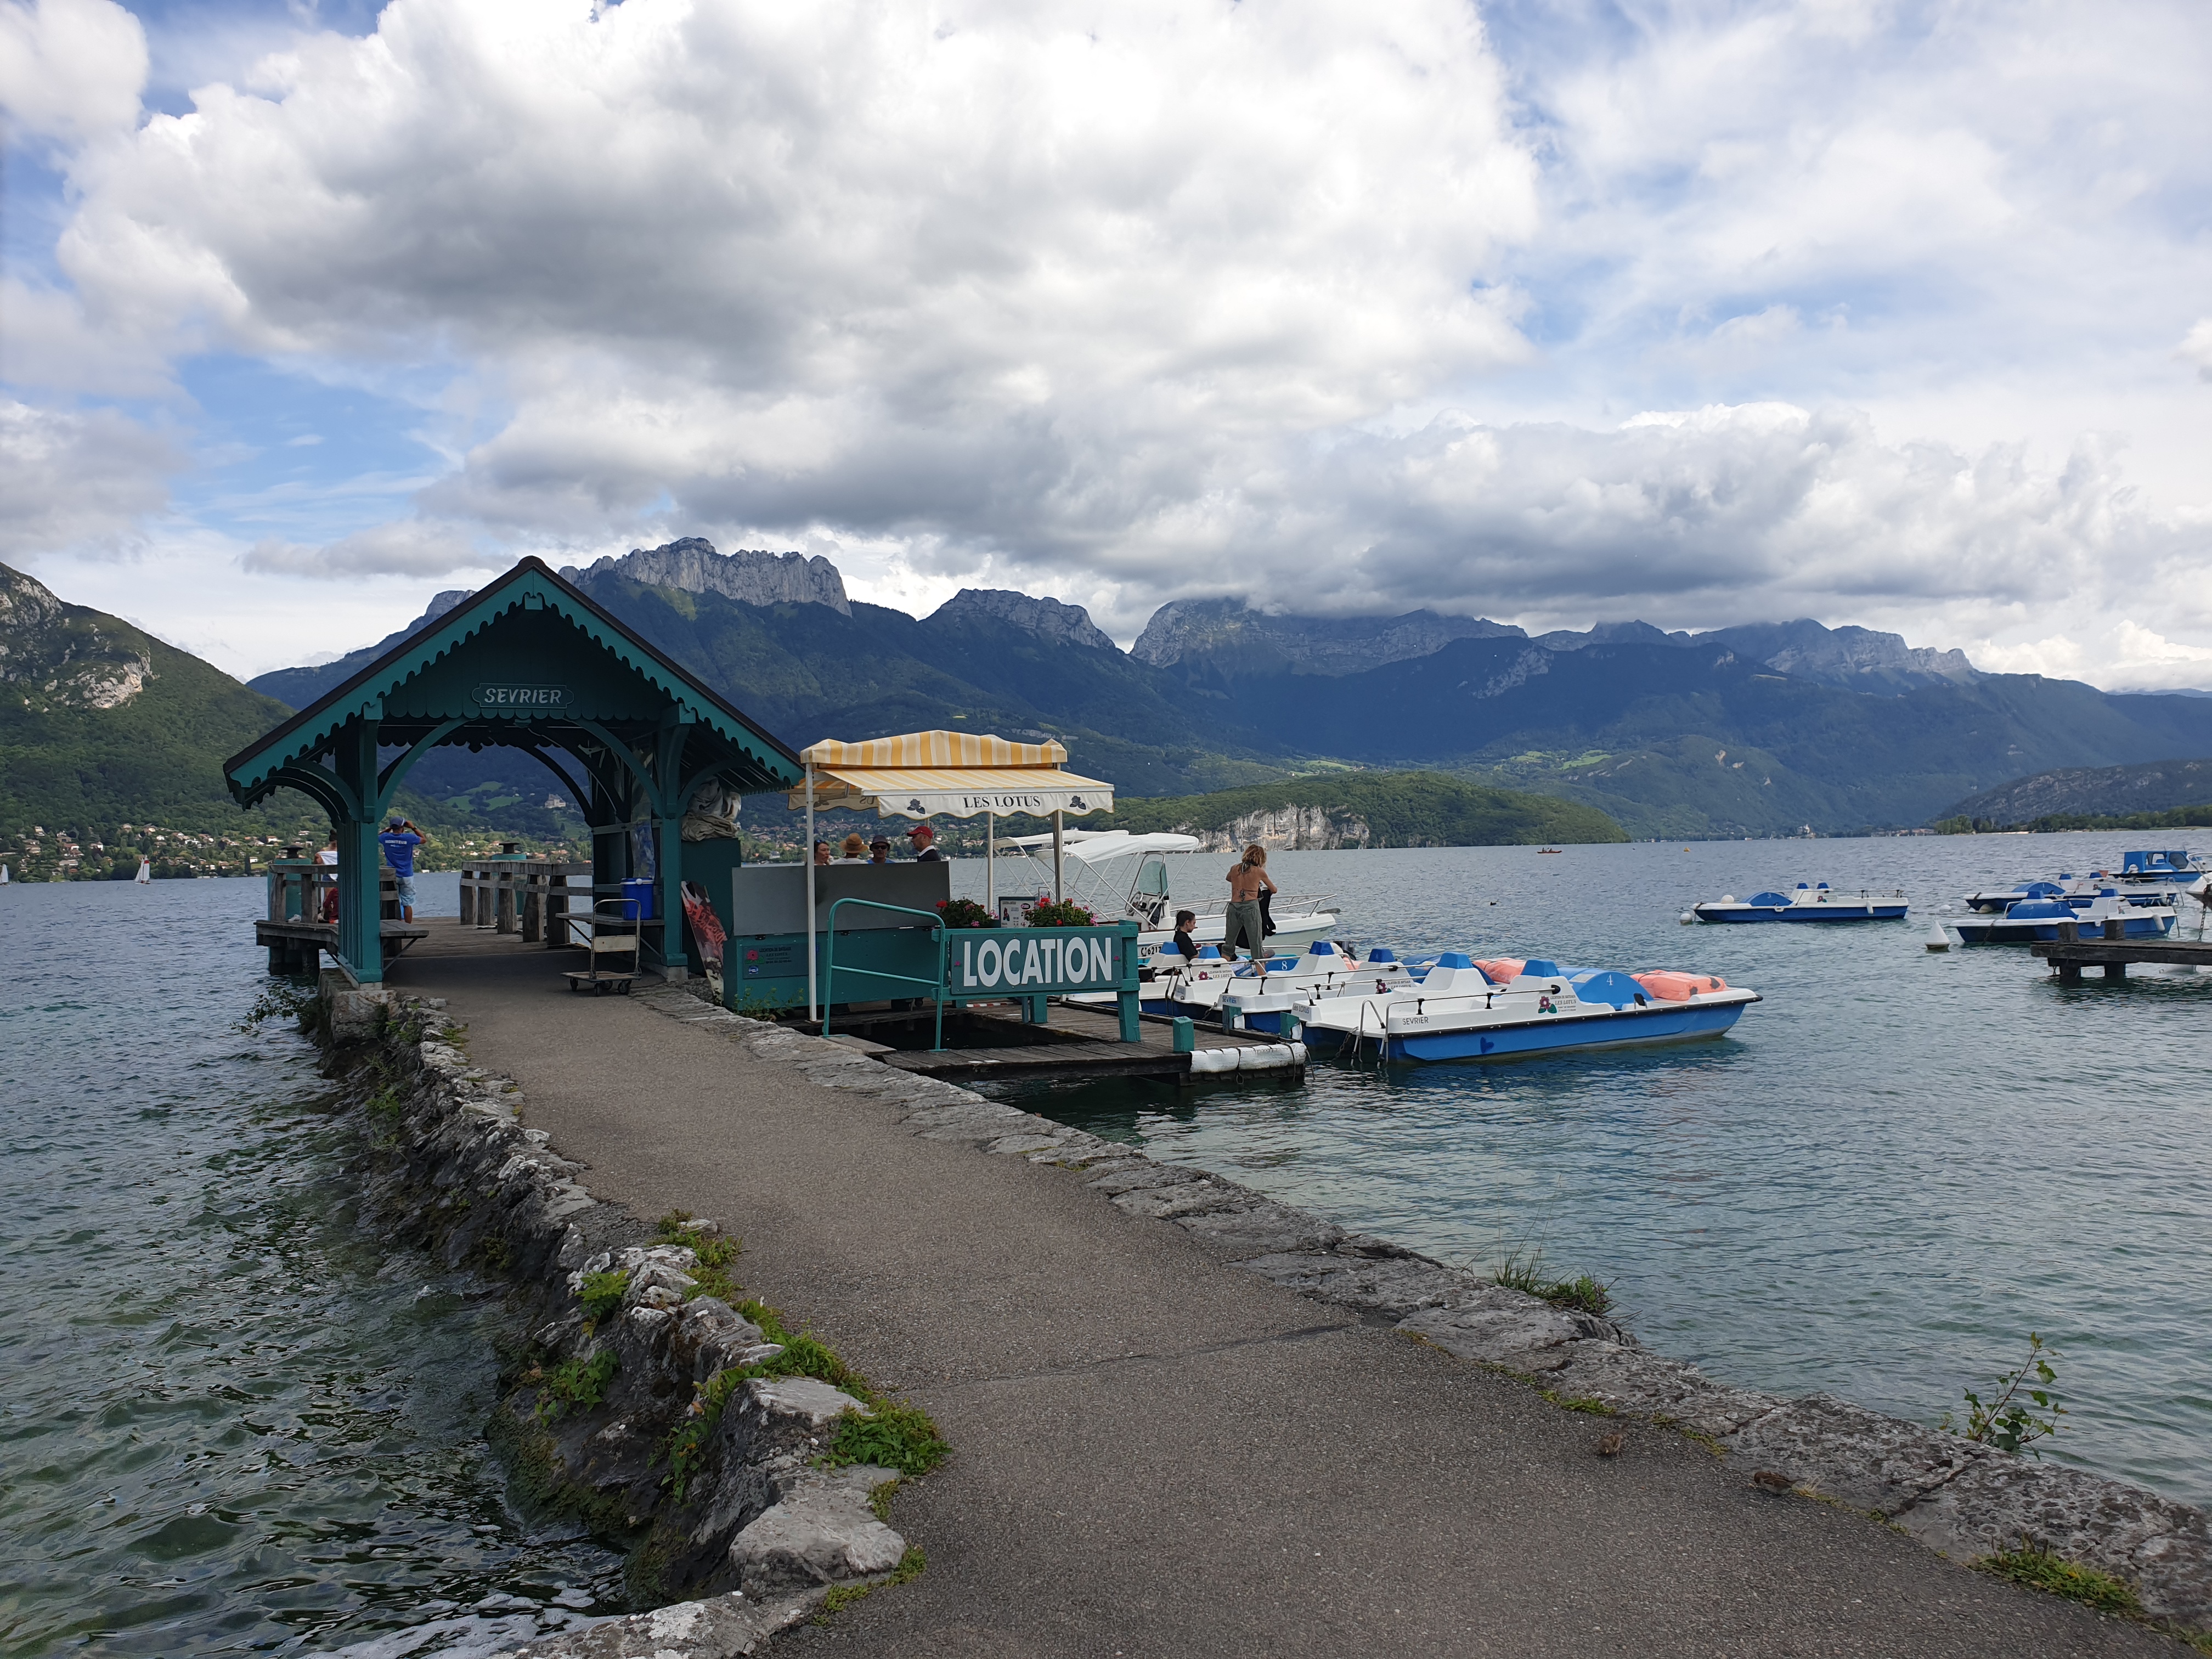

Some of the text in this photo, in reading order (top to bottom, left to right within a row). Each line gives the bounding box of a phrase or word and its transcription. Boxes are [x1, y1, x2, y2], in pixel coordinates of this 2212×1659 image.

[484, 688, 562, 704] SEVRIER
[963, 795, 1041, 808] LES LOTUS
[963, 936, 1112, 987] LOCATION
[1282, 960, 1288, 970] 8
[1606, 974, 1613, 986] 4
[1402, 1016, 1429, 1025] SEVRIER
